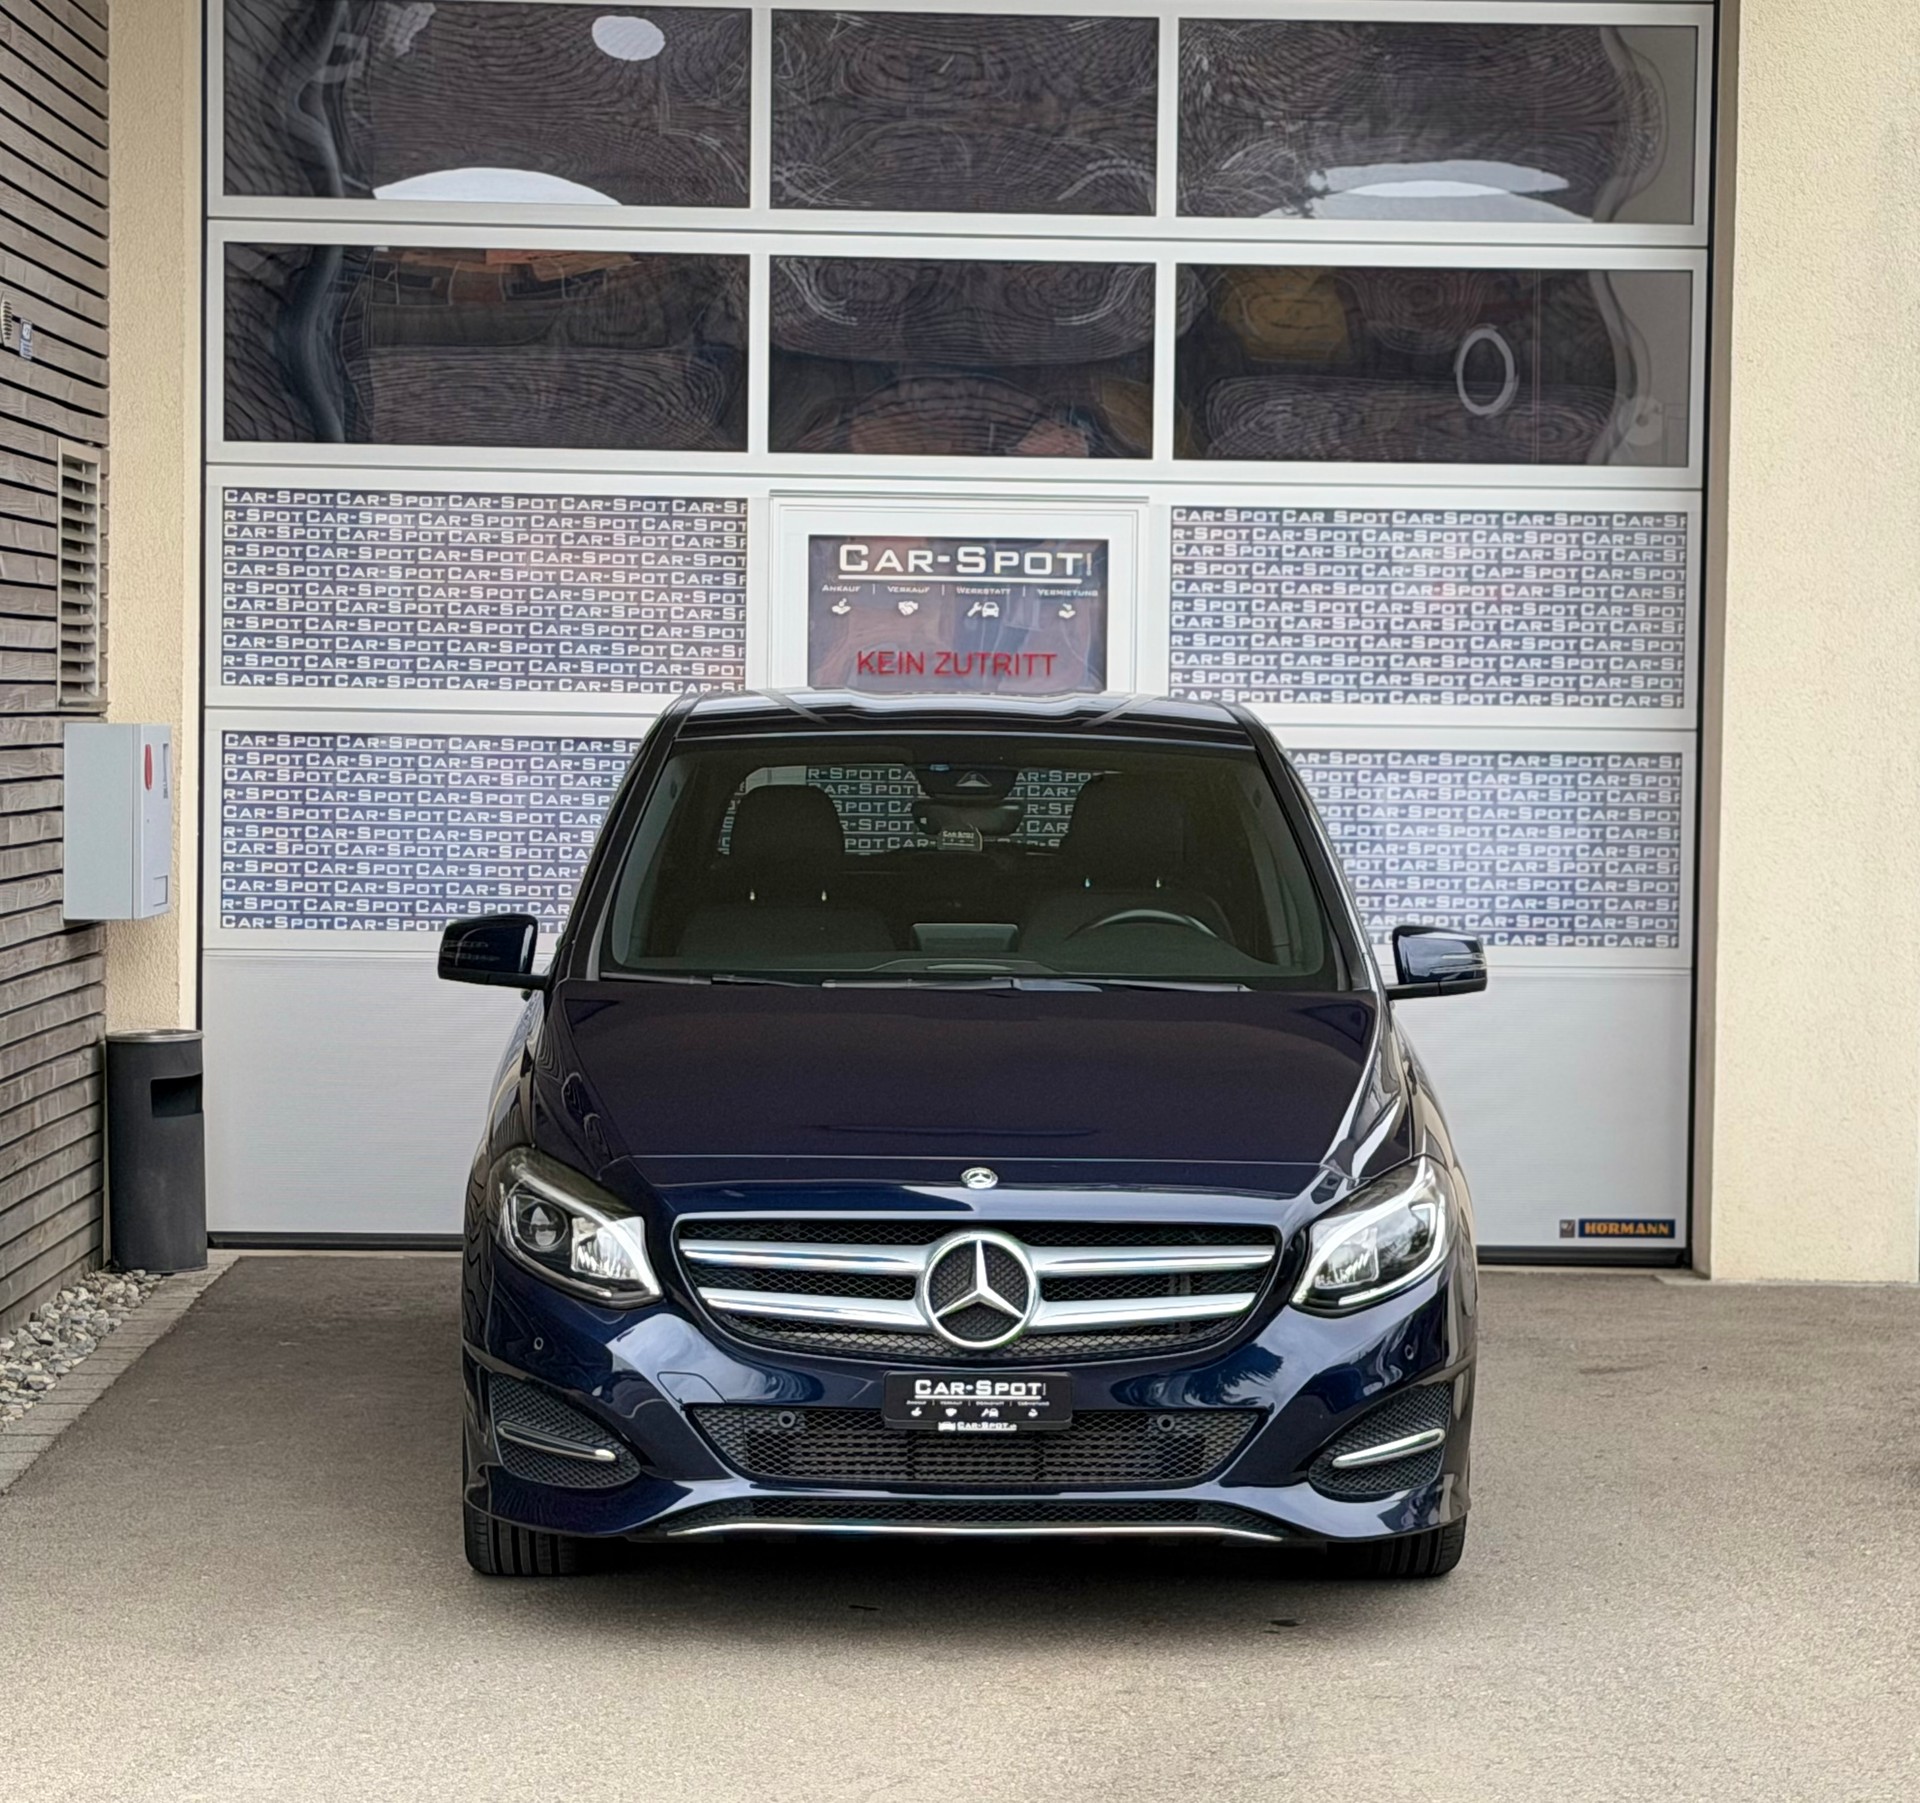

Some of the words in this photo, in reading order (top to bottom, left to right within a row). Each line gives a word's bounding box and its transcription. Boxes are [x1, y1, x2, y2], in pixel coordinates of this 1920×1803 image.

[839, 544, 1083, 575] CAR-SPOT
[857, 651, 925, 675] KEIN
[933, 652, 1057, 677] ZUTRITT
[915, 1379, 1042, 1395] CAR-SPOT
